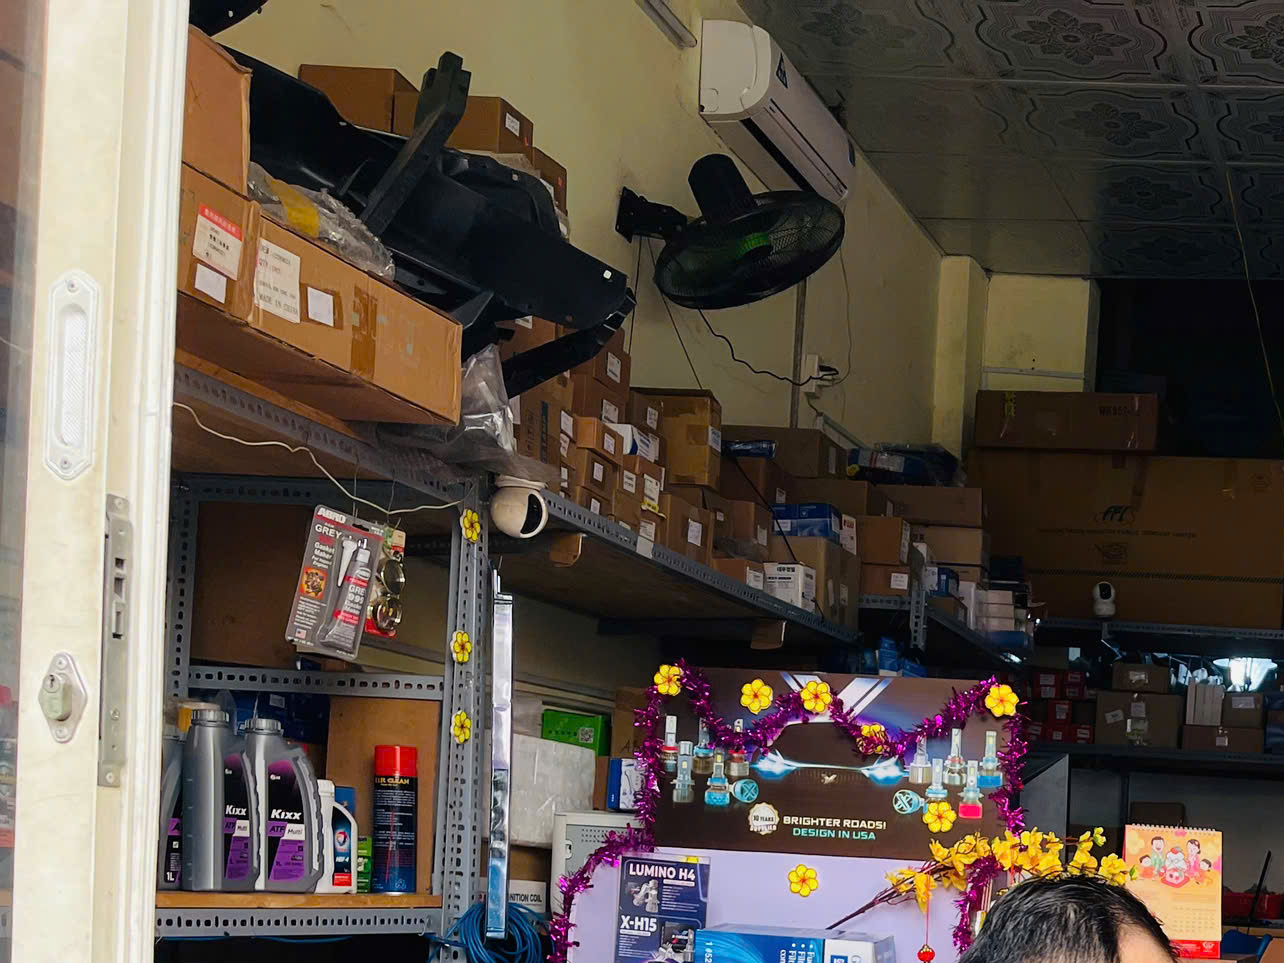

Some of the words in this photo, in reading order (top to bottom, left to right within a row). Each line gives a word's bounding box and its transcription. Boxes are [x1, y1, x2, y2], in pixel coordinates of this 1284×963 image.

[317, 507, 346, 524] ABRO
[315, 524, 342, 541] GREY
[348, 584, 366, 596] GRE
[226, 804, 247, 816] Kixx
[271, 809, 301, 820] Kixx
[225, 822, 236, 830] ATF
[783, 815, 841, 828] BRIGHTER
[843, 819, 887, 830] ROADS!
[269, 825, 285, 833] ATF
[792, 828, 835, 838] DESIGN
[838, 830, 849, 838] IN
[852, 832, 876, 840] USA
[166, 872, 174, 881] 1L
[629, 864, 677, 879] LUMINO
[679, 868, 696, 881] H4
[510, 893, 529, 902] NITION
[530, 893, 543, 903] COIL
[620, 915, 657, 932] X-H15
